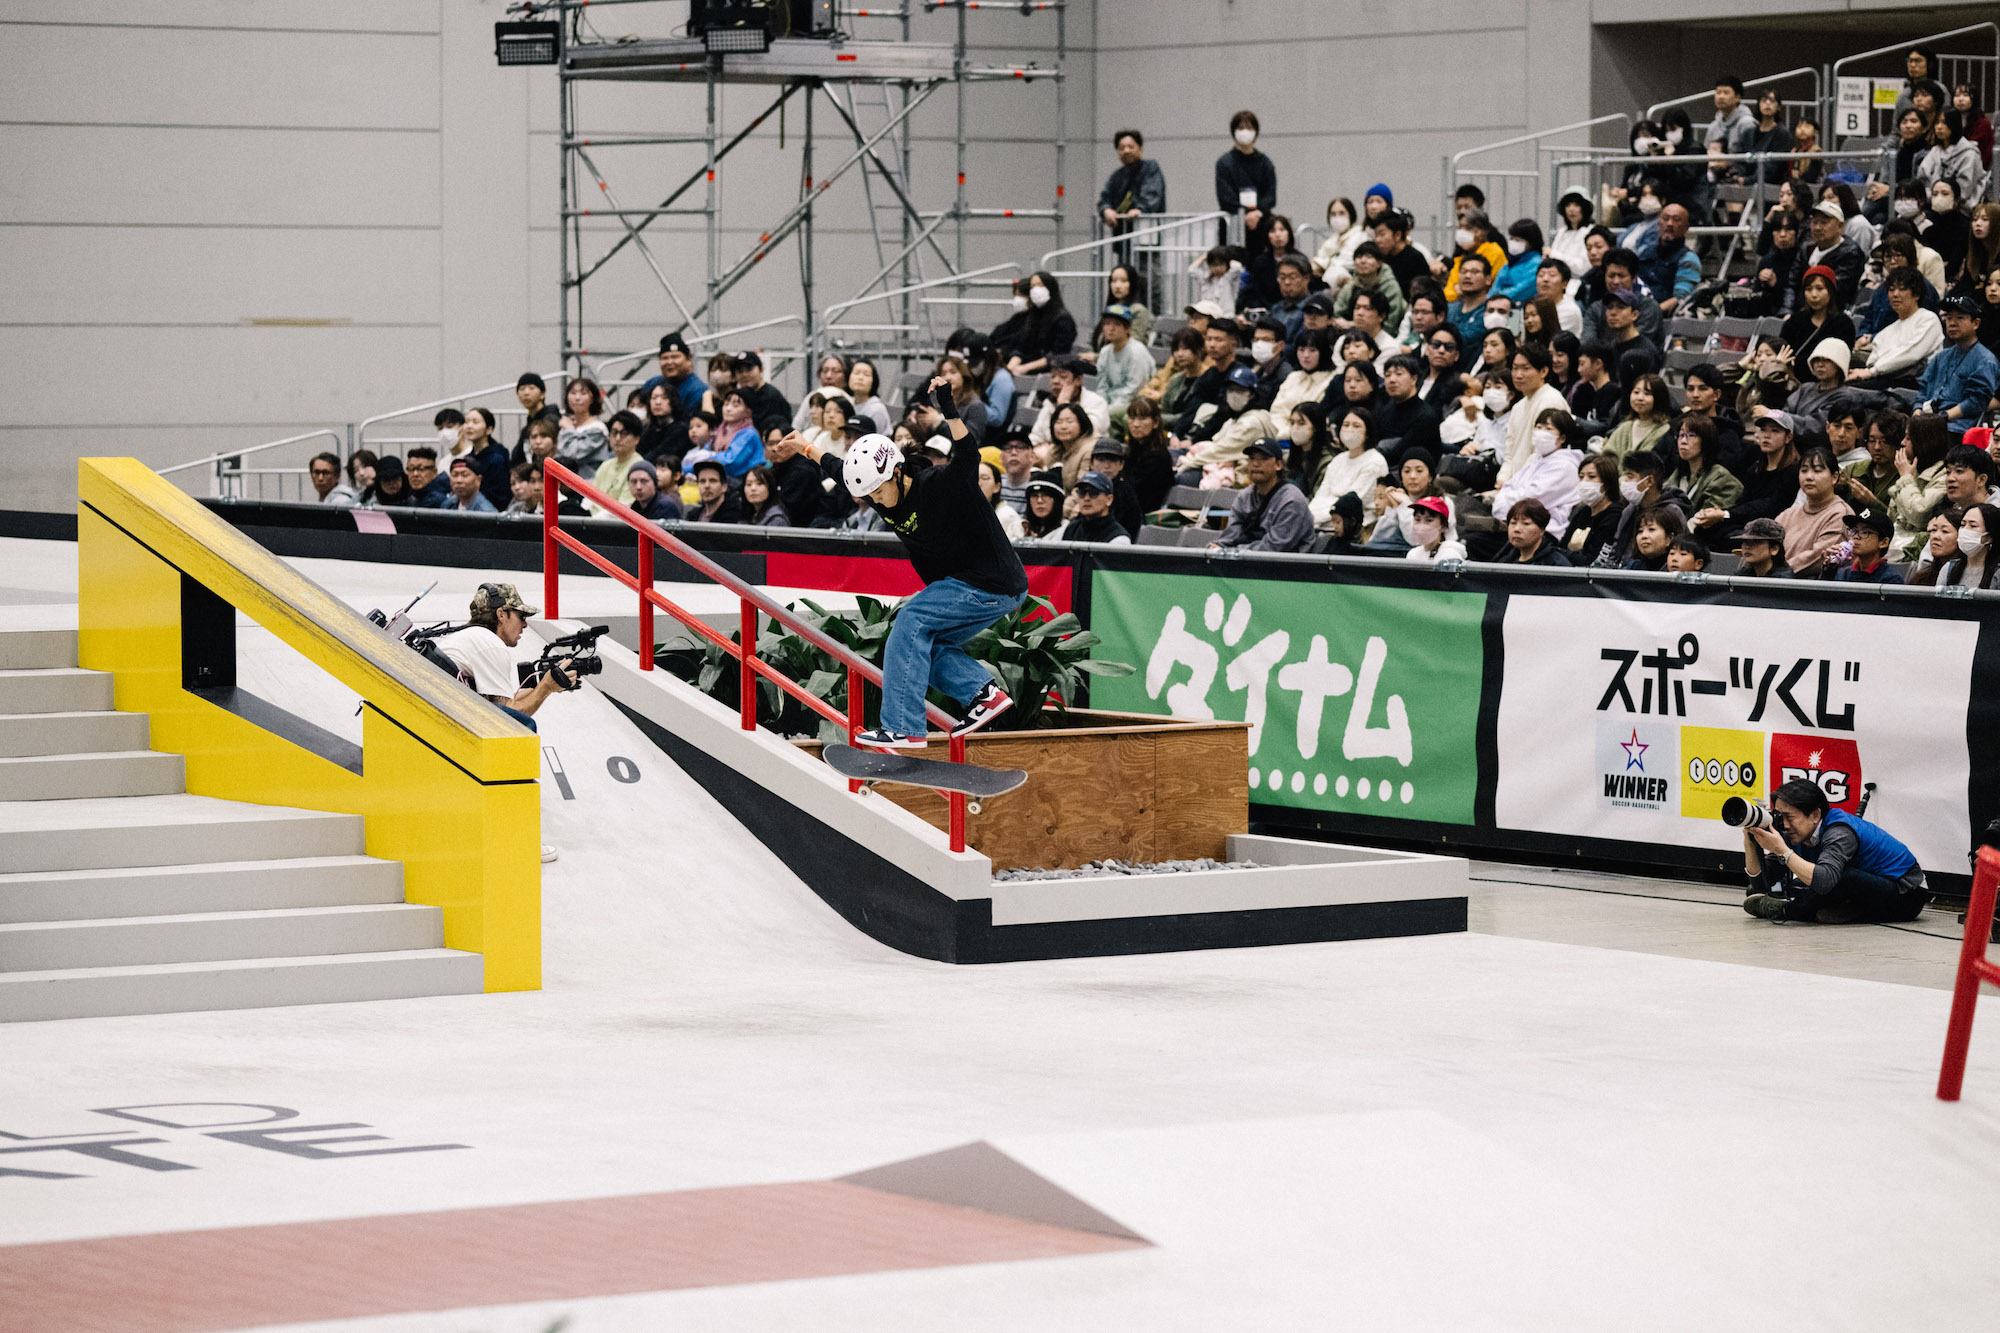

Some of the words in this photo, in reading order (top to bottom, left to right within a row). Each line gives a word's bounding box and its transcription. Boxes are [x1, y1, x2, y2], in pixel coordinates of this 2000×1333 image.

[1847, 113, 1858, 130] B
[872, 443, 888, 465] NIKE
[1145, 592, 1413, 768] ダイナム
[1596, 633, 1861, 732] スポーツくじ
[1690, 757, 1756, 787] toto
[1604, 774, 1668, 802] WINNER
[0, 1122, 474, 1180] TE
